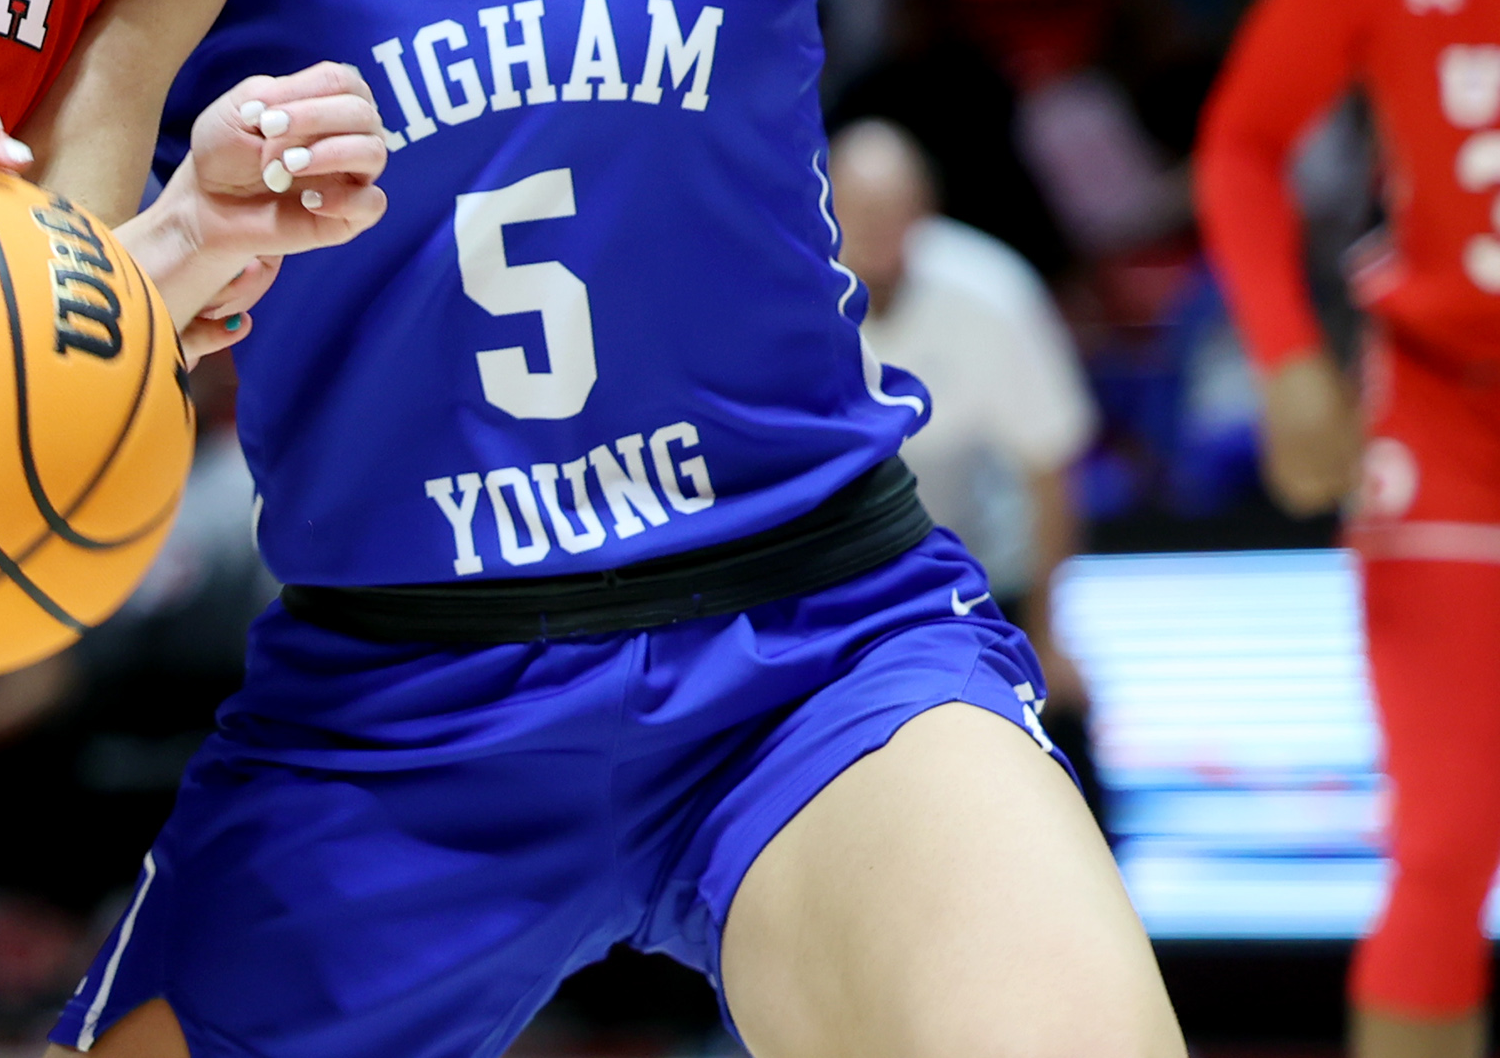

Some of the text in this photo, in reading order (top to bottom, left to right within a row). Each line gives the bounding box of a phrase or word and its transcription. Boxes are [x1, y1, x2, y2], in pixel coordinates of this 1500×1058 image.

[31, 197, 122, 360] Wil
[454, 167, 598, 420] 5
[424, 421, 716, 576] YOUNG
